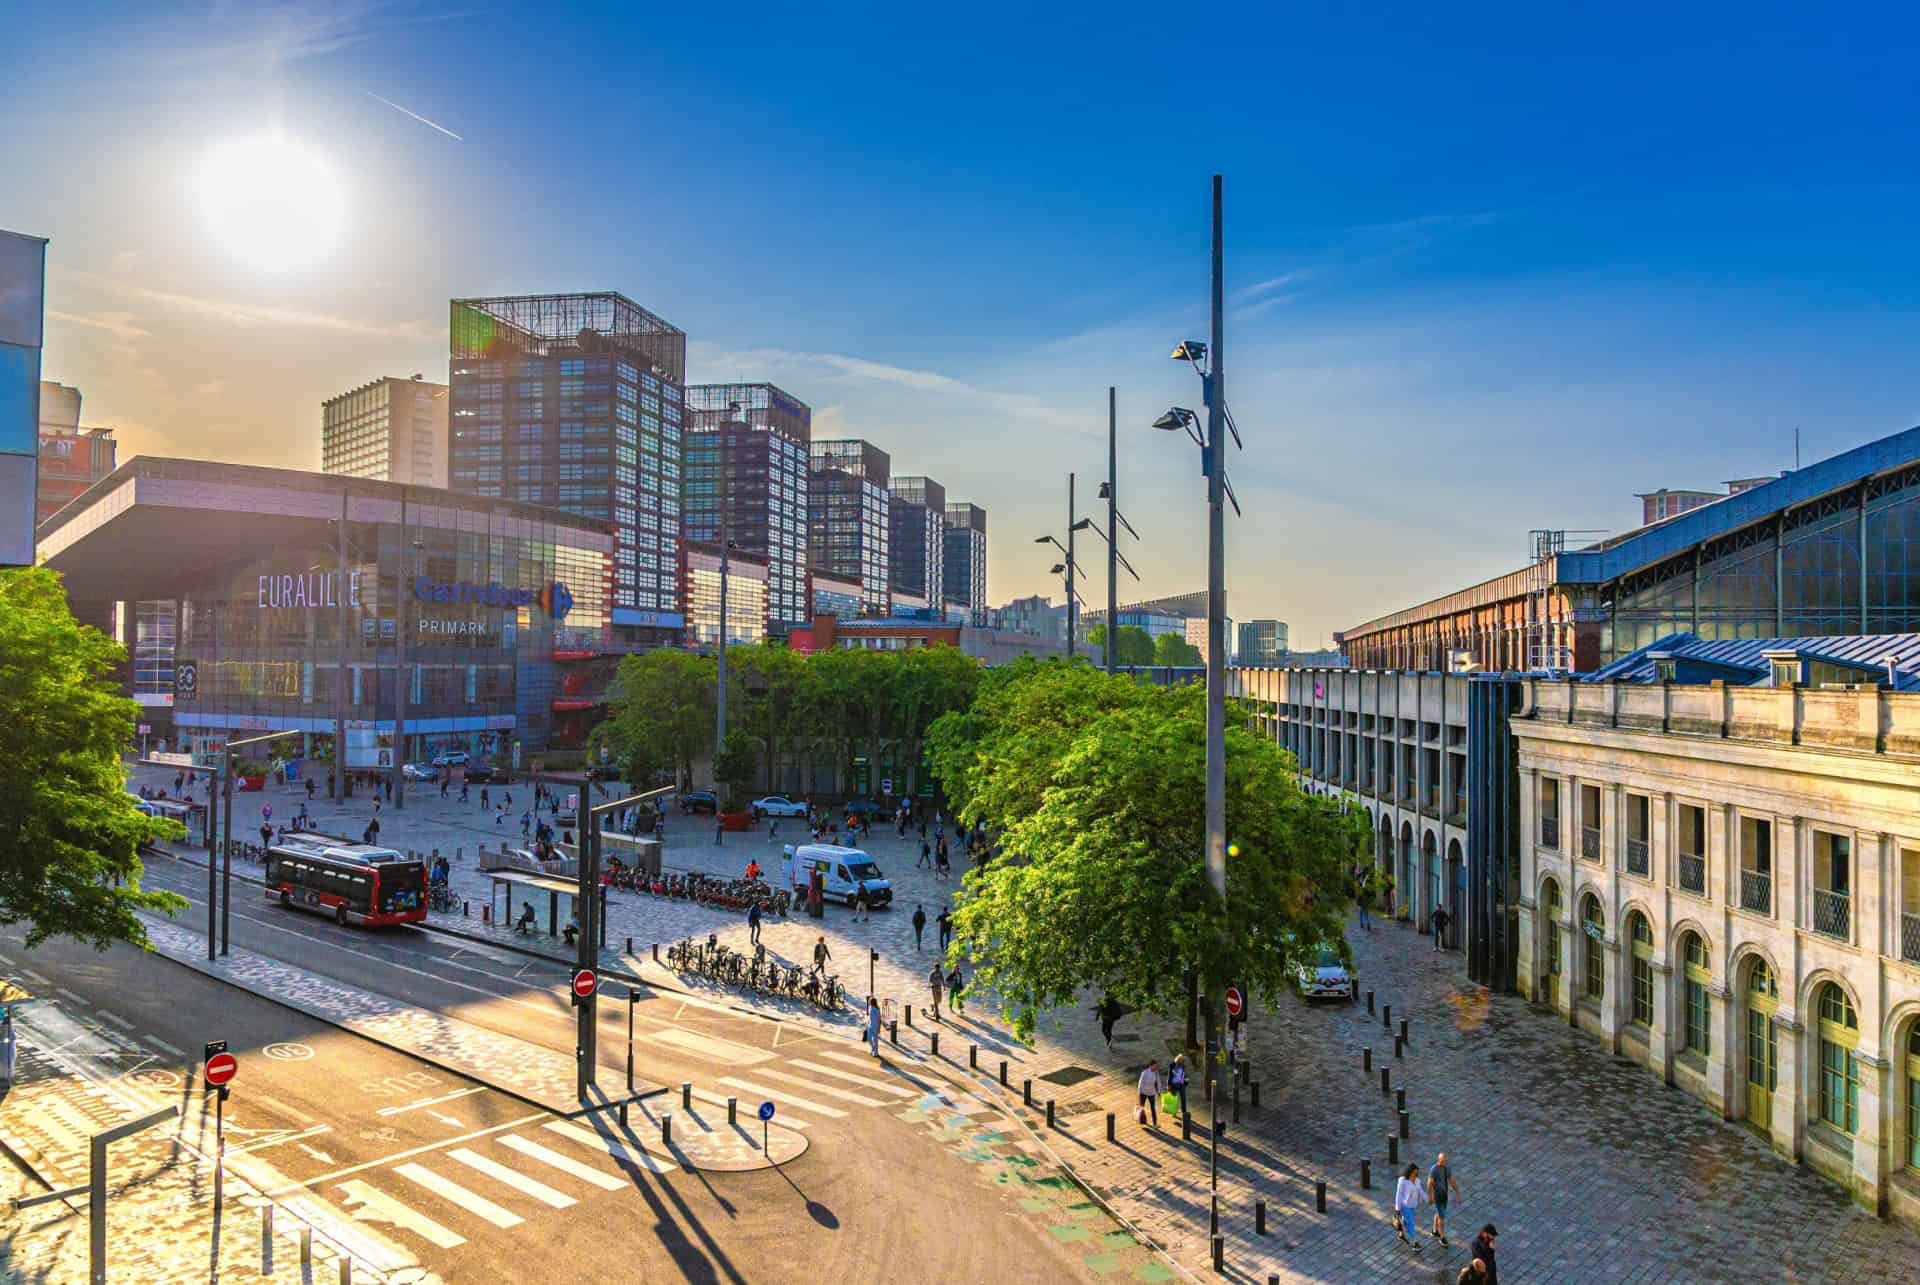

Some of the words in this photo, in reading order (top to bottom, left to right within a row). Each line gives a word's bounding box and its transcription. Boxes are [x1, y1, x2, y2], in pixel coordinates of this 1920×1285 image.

[419, 619, 487, 635] PRIMARK
[271, 1045, 306, 1058] 30
[360, 1071, 442, 1097] BUS
